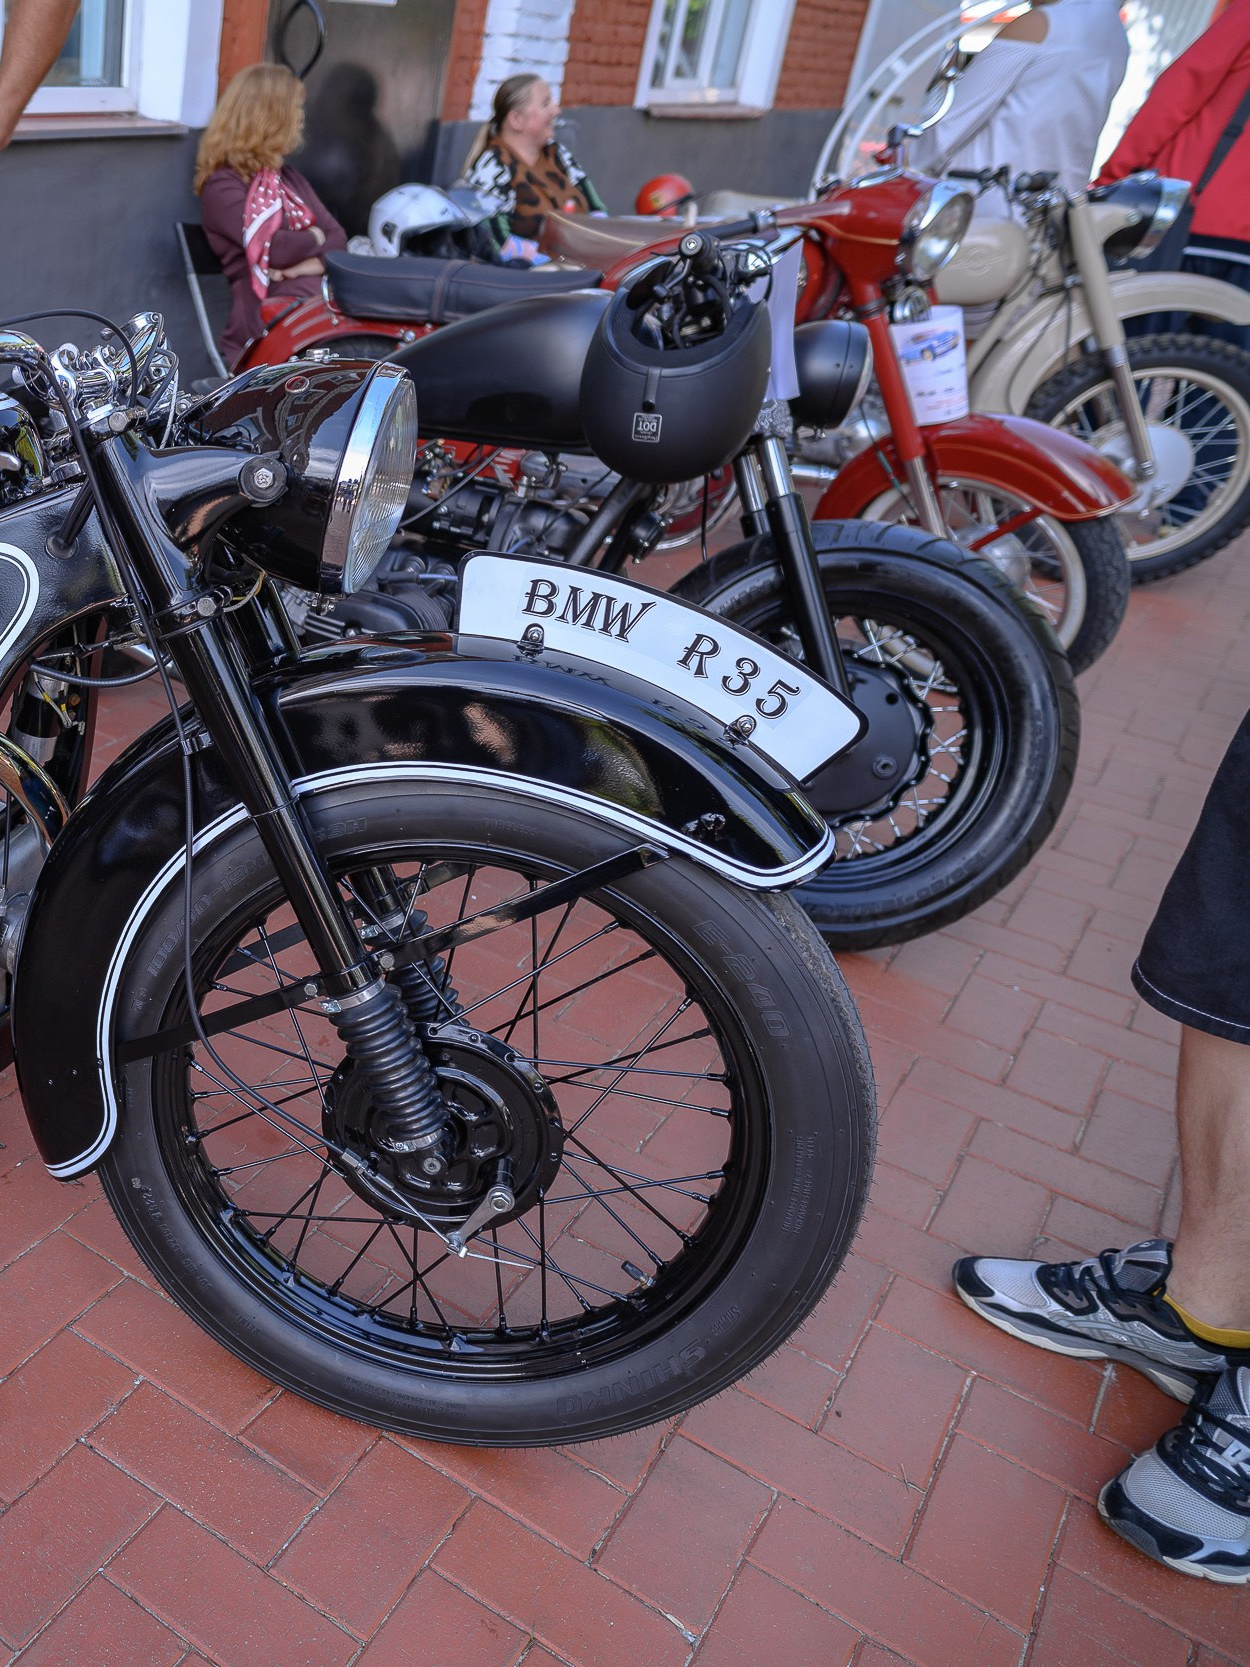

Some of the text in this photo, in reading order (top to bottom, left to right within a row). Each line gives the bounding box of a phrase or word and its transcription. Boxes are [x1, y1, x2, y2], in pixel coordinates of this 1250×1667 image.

[637, 421, 657, 432] DOT
[522, 578, 656, 643] BMW
[556, 1339, 707, 1416] SHINKO
